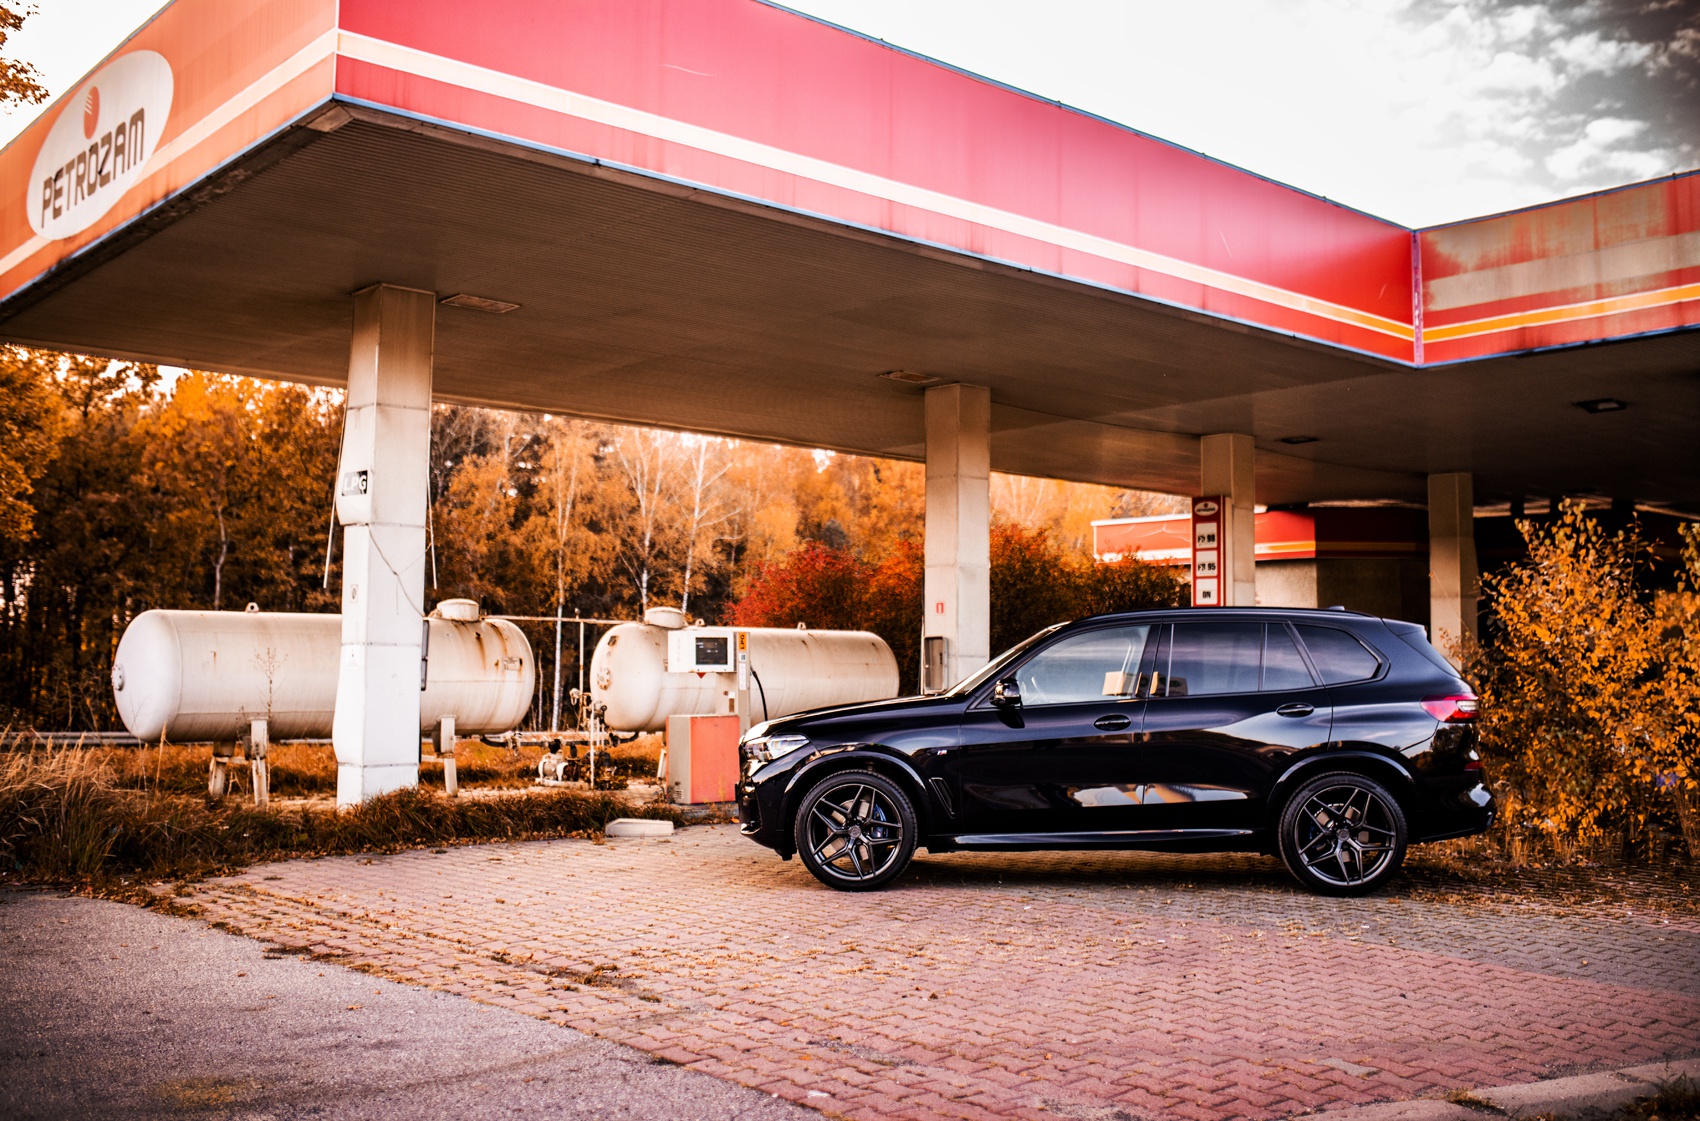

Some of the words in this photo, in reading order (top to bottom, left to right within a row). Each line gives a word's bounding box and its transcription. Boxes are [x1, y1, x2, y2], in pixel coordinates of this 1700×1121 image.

[41, 107, 145, 228] PETROZAM
[344, 475, 367, 491] LPG
[1207, 563, 1216, 571] 95
[1202, 591, 1211, 599] ON
